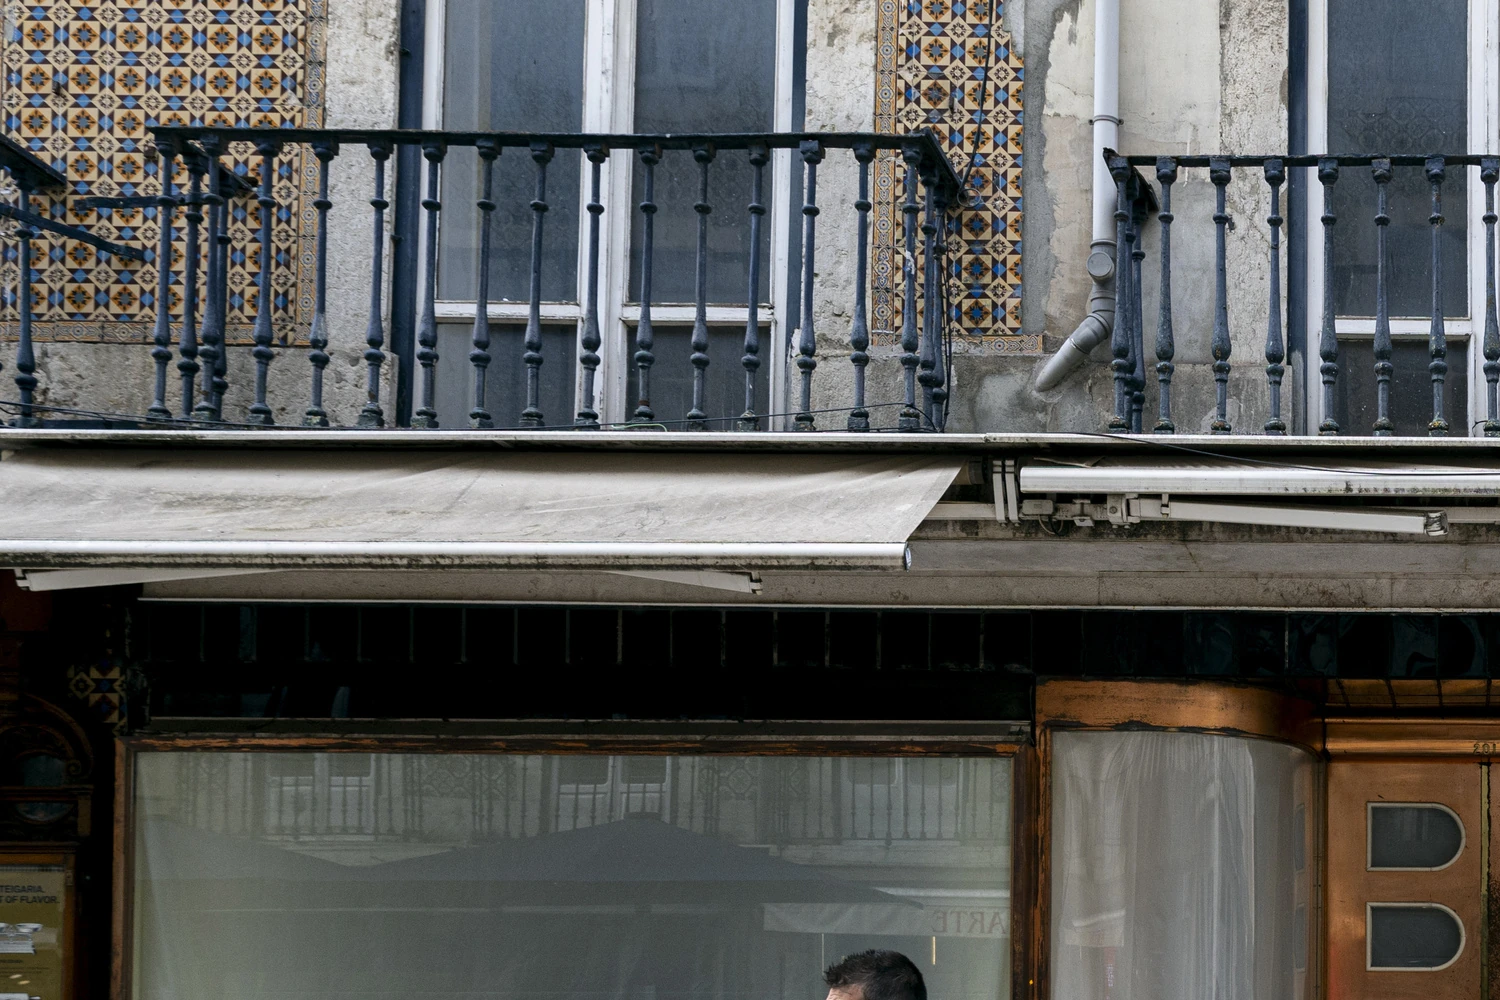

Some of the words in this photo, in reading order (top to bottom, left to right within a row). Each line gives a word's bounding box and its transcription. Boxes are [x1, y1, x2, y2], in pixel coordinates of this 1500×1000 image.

[1473, 743, 1497, 756] 201
[5, 895, 18, 903] OF
[20, 895, 60, 903] FLAVOR.
